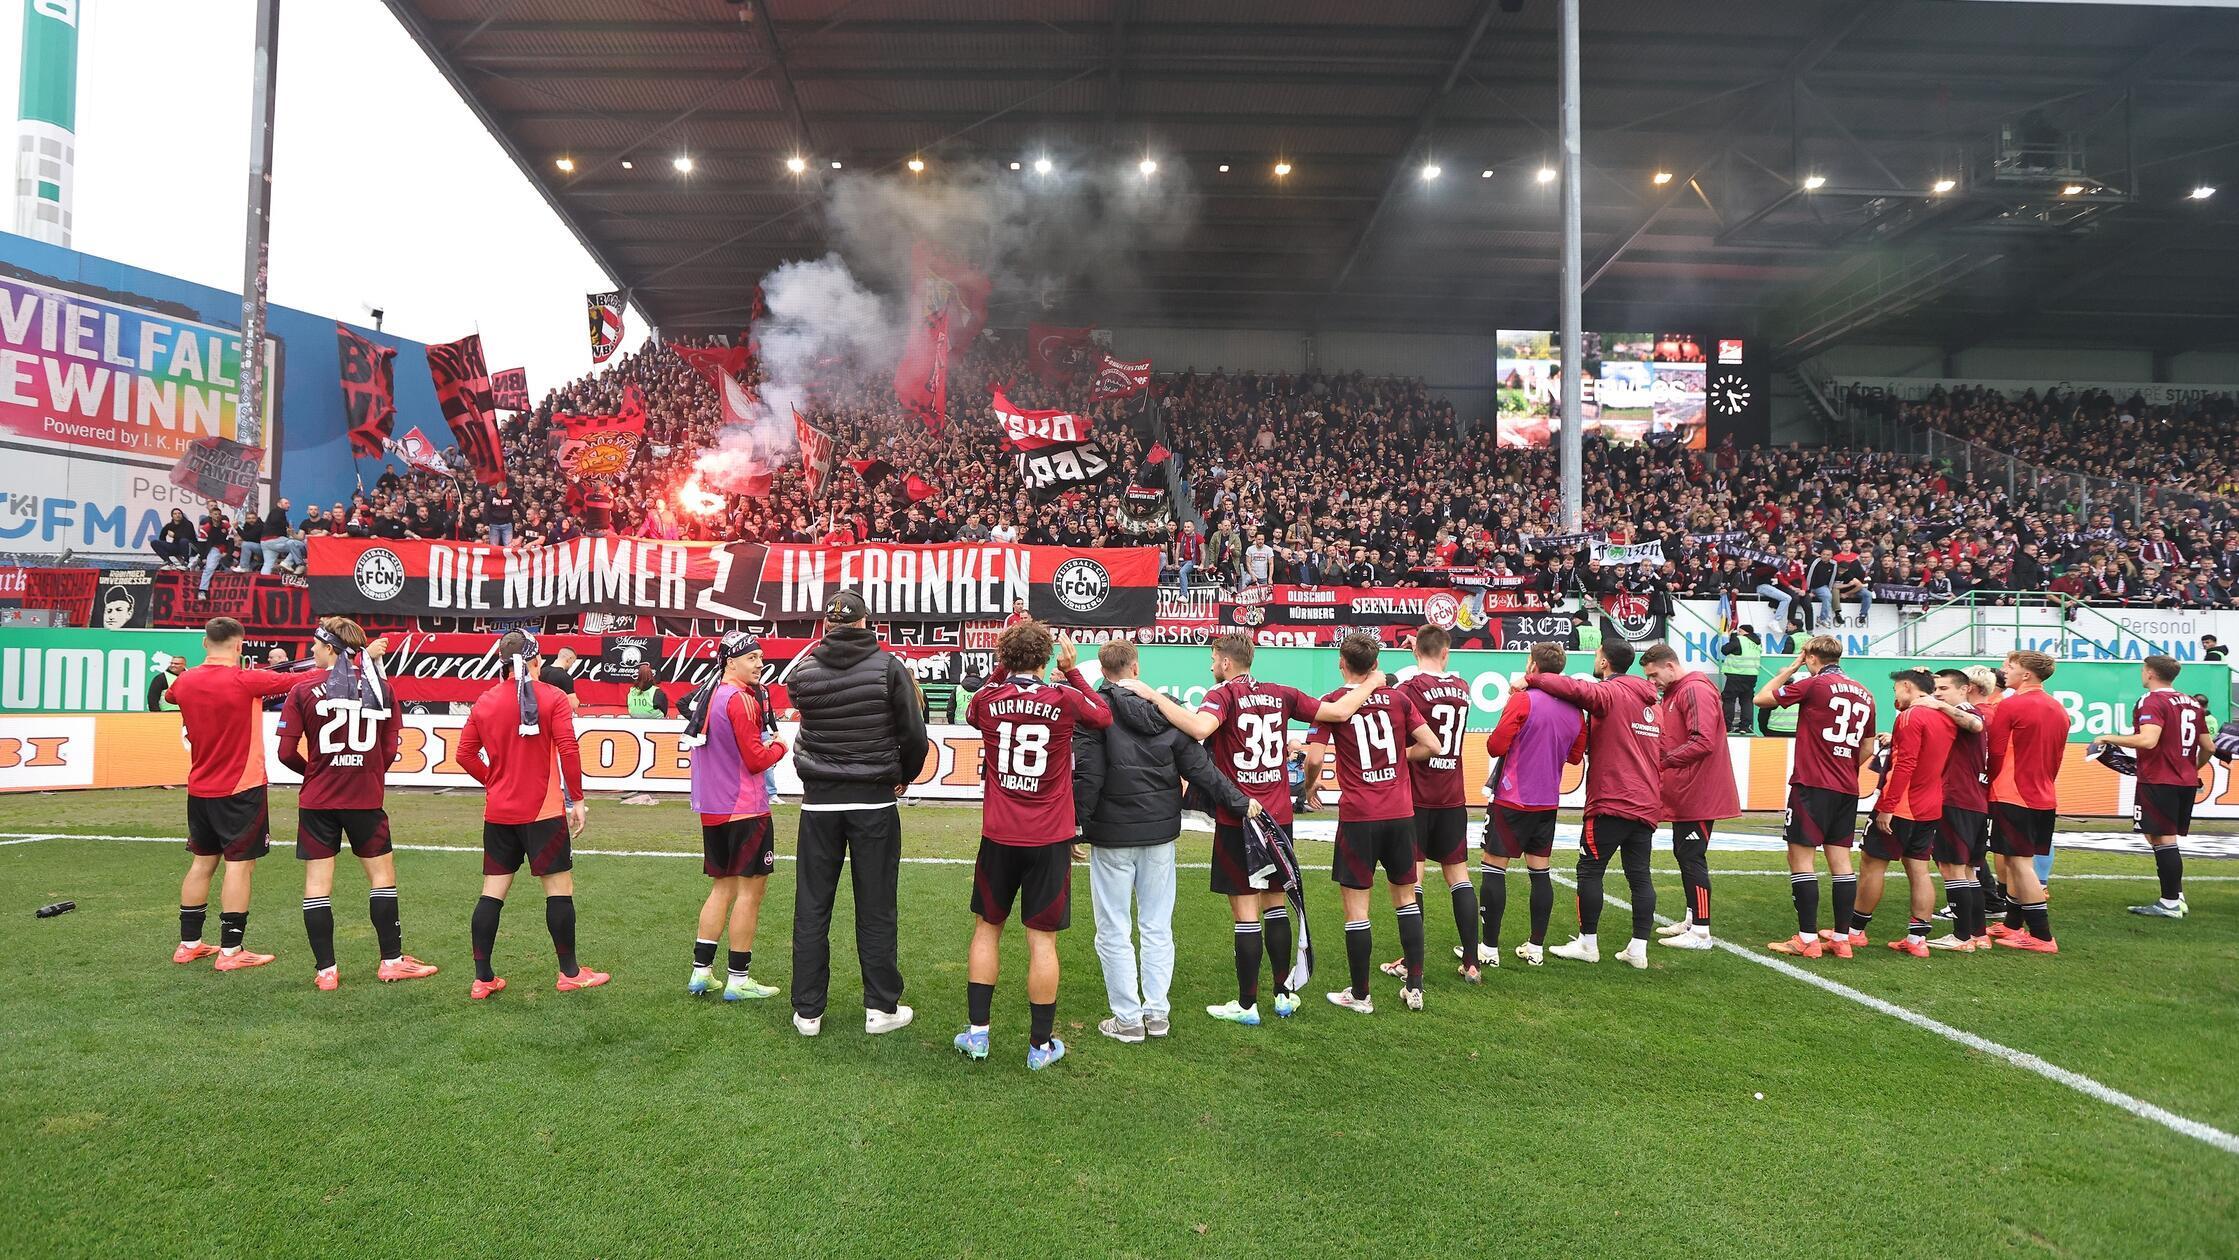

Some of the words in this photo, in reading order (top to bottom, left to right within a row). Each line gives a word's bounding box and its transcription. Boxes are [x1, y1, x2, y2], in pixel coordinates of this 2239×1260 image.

[0, 288, 243, 388] VIELFAL
[44, 417, 115, 442] Powered
[121, 424, 139, 449] by
[375, 558, 385, 571] 1.
[1076, 567, 1088, 582] 1.
[366, 571, 394, 585] FCN
[428, 544, 490, 610] DIE
[503, 537, 687, 610] NUMMER
[696, 540, 769, 620] 1
[781, 549, 824, 613] IN
[840, 547, 1030, 614] FRANKEN
[1065, 581, 1098, 596] FCN
[183, 588, 248, 601] STDION
[1287, 591, 1336, 603] OLDSCHOOL
[1289, 606, 1335, 620] NÜRNBERG
[2121, 617, 2196, 636] Personal
[966, 631, 1000, 648] VERB
[633, 698, 648, 707] 110
[989, 699, 1061, 722] NÜRNBERG
[315, 699, 382, 754] 20
[1430, 704, 1468, 757] 31
[1822, 696, 1871, 748] 33
[2180, 708, 2197, 747] 6
[996, 721, 1051, 778] 18
[1233, 712, 1284, 771] 36
[1349, 709, 1398, 771] 14
[1362, 767, 1397, 783] GOLLER
